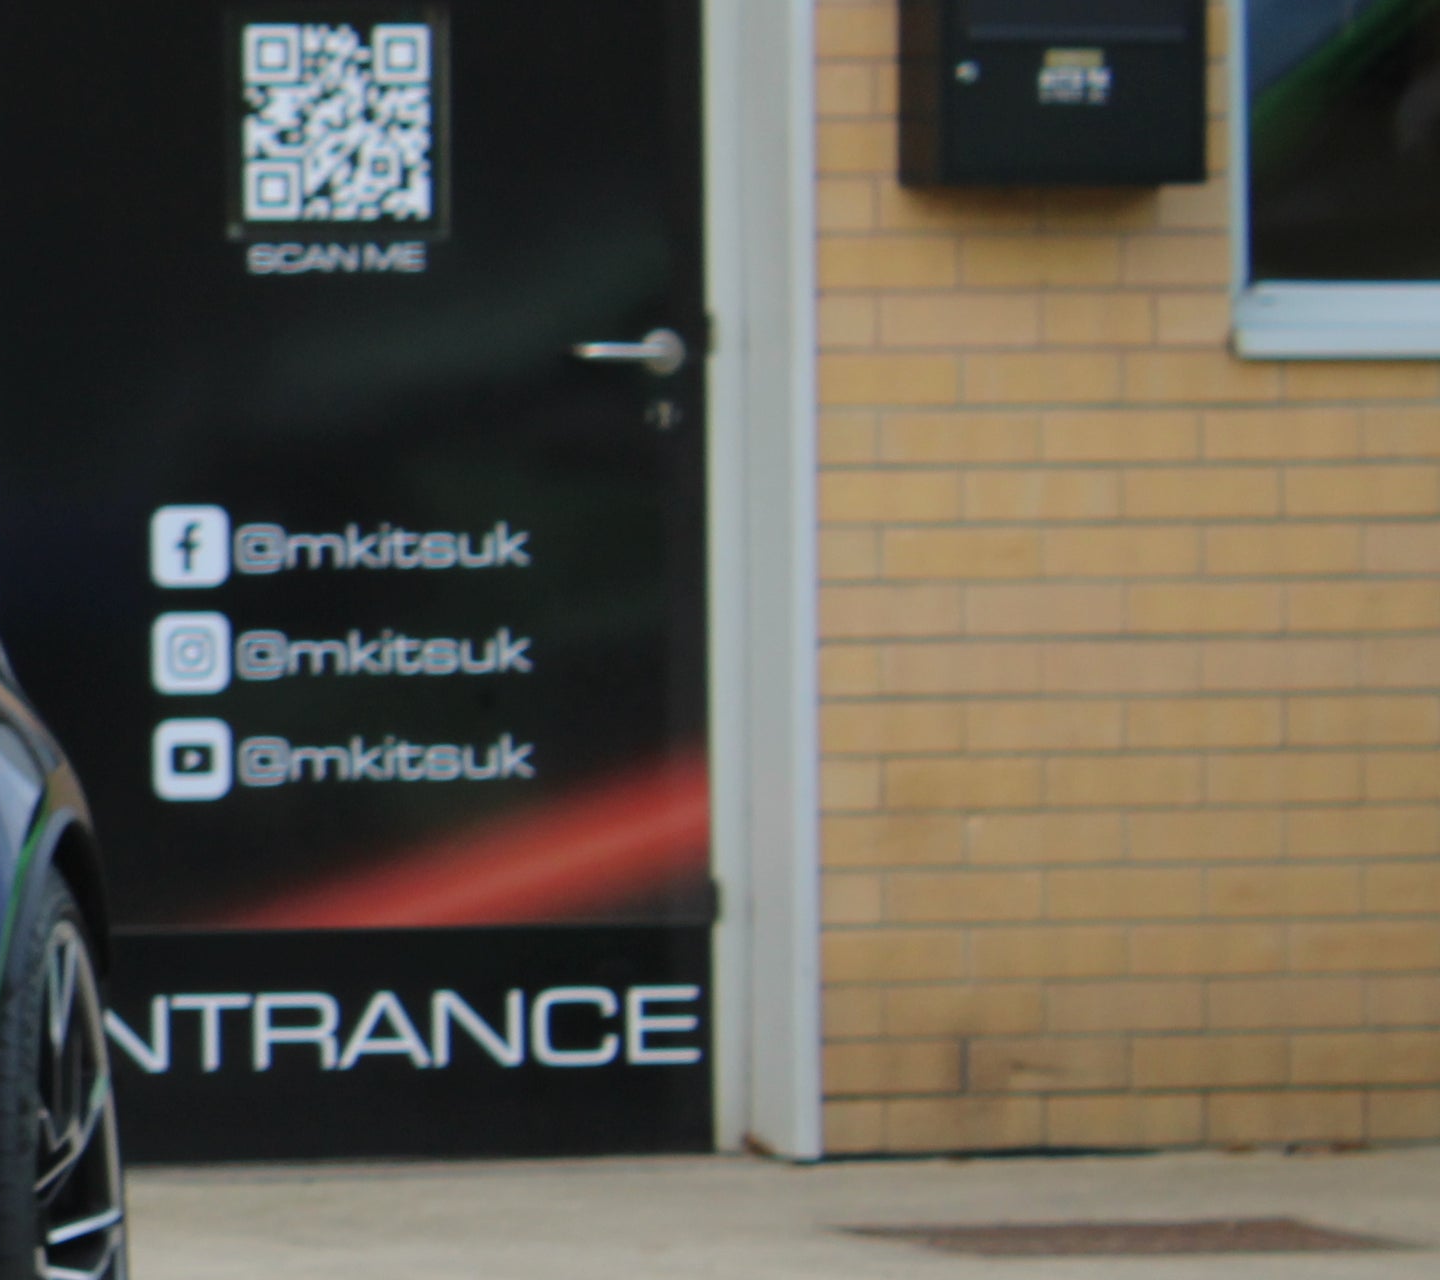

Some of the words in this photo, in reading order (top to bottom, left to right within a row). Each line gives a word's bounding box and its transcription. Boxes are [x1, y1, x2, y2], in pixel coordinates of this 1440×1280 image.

[247, 243, 359, 275] SCAN
[363, 242, 425, 272] ME
[233, 522, 531, 574] @mkitsuk
[236, 628, 533, 680] @mkitsuk
[237, 734, 535, 786] @mkitsuk
[105, 985, 701, 1073] NTRANCE
